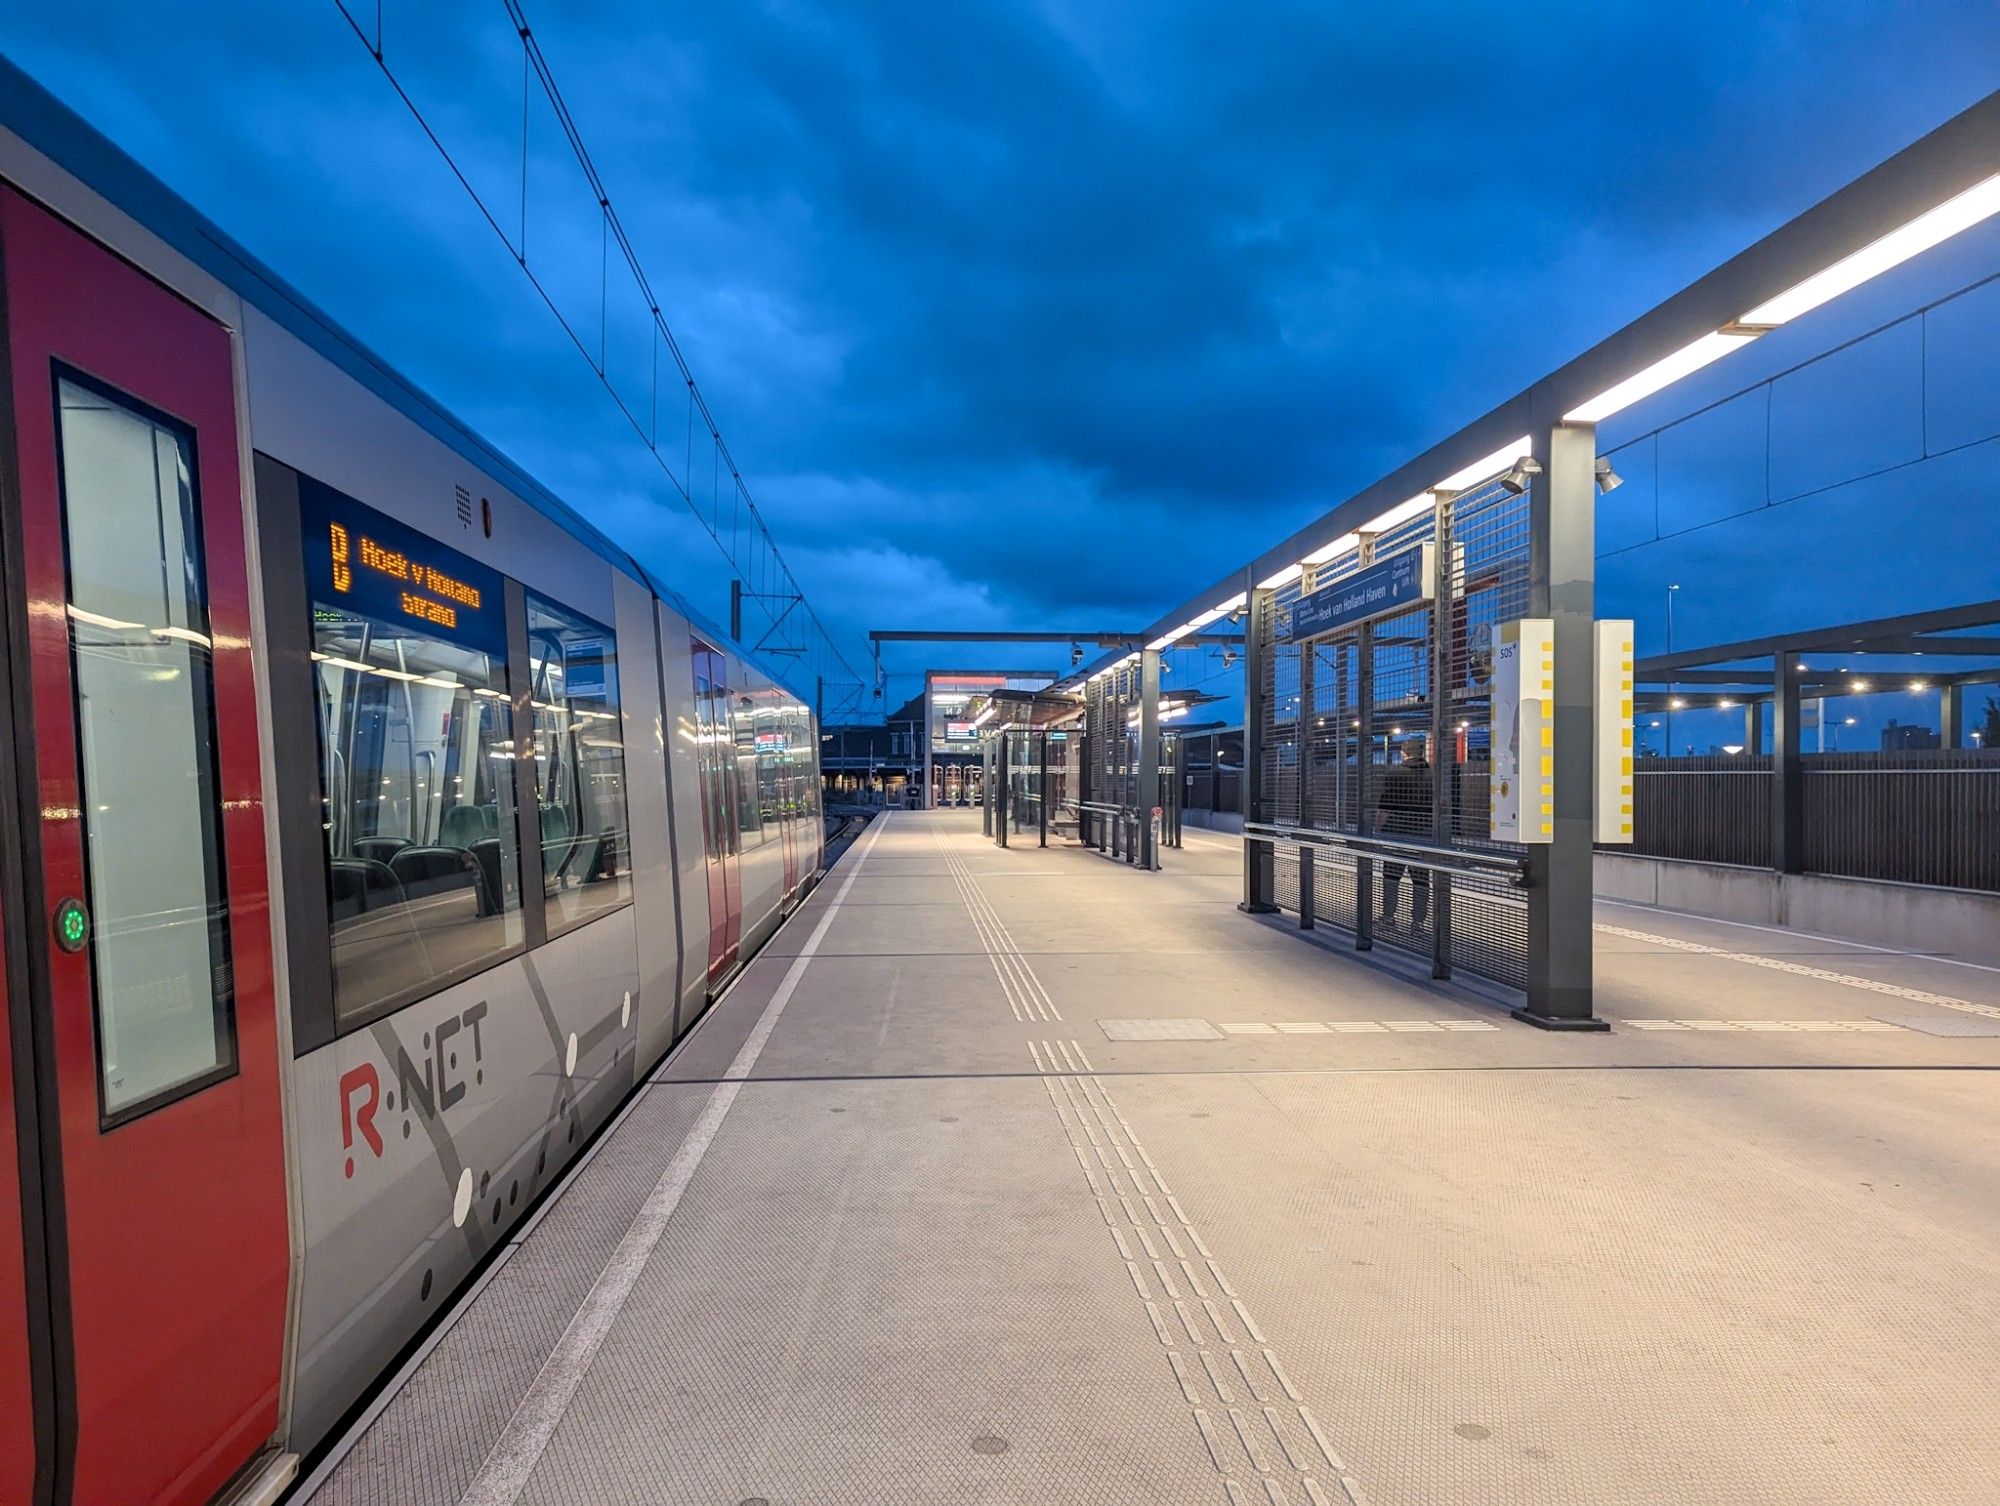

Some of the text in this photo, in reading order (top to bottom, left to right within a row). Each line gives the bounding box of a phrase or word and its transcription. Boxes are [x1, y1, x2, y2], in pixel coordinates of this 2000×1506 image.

[360, 536, 409, 580] Hoek
[411, 563, 423, 585] v
[1319, 604, 1332, 621] Hoek
[1332, 602, 1343, 616] van
[1343, 590, 1365, 612] Holland
[1366, 586, 1386, 603] Haven
[1500, 647, 1513, 660] SOS
